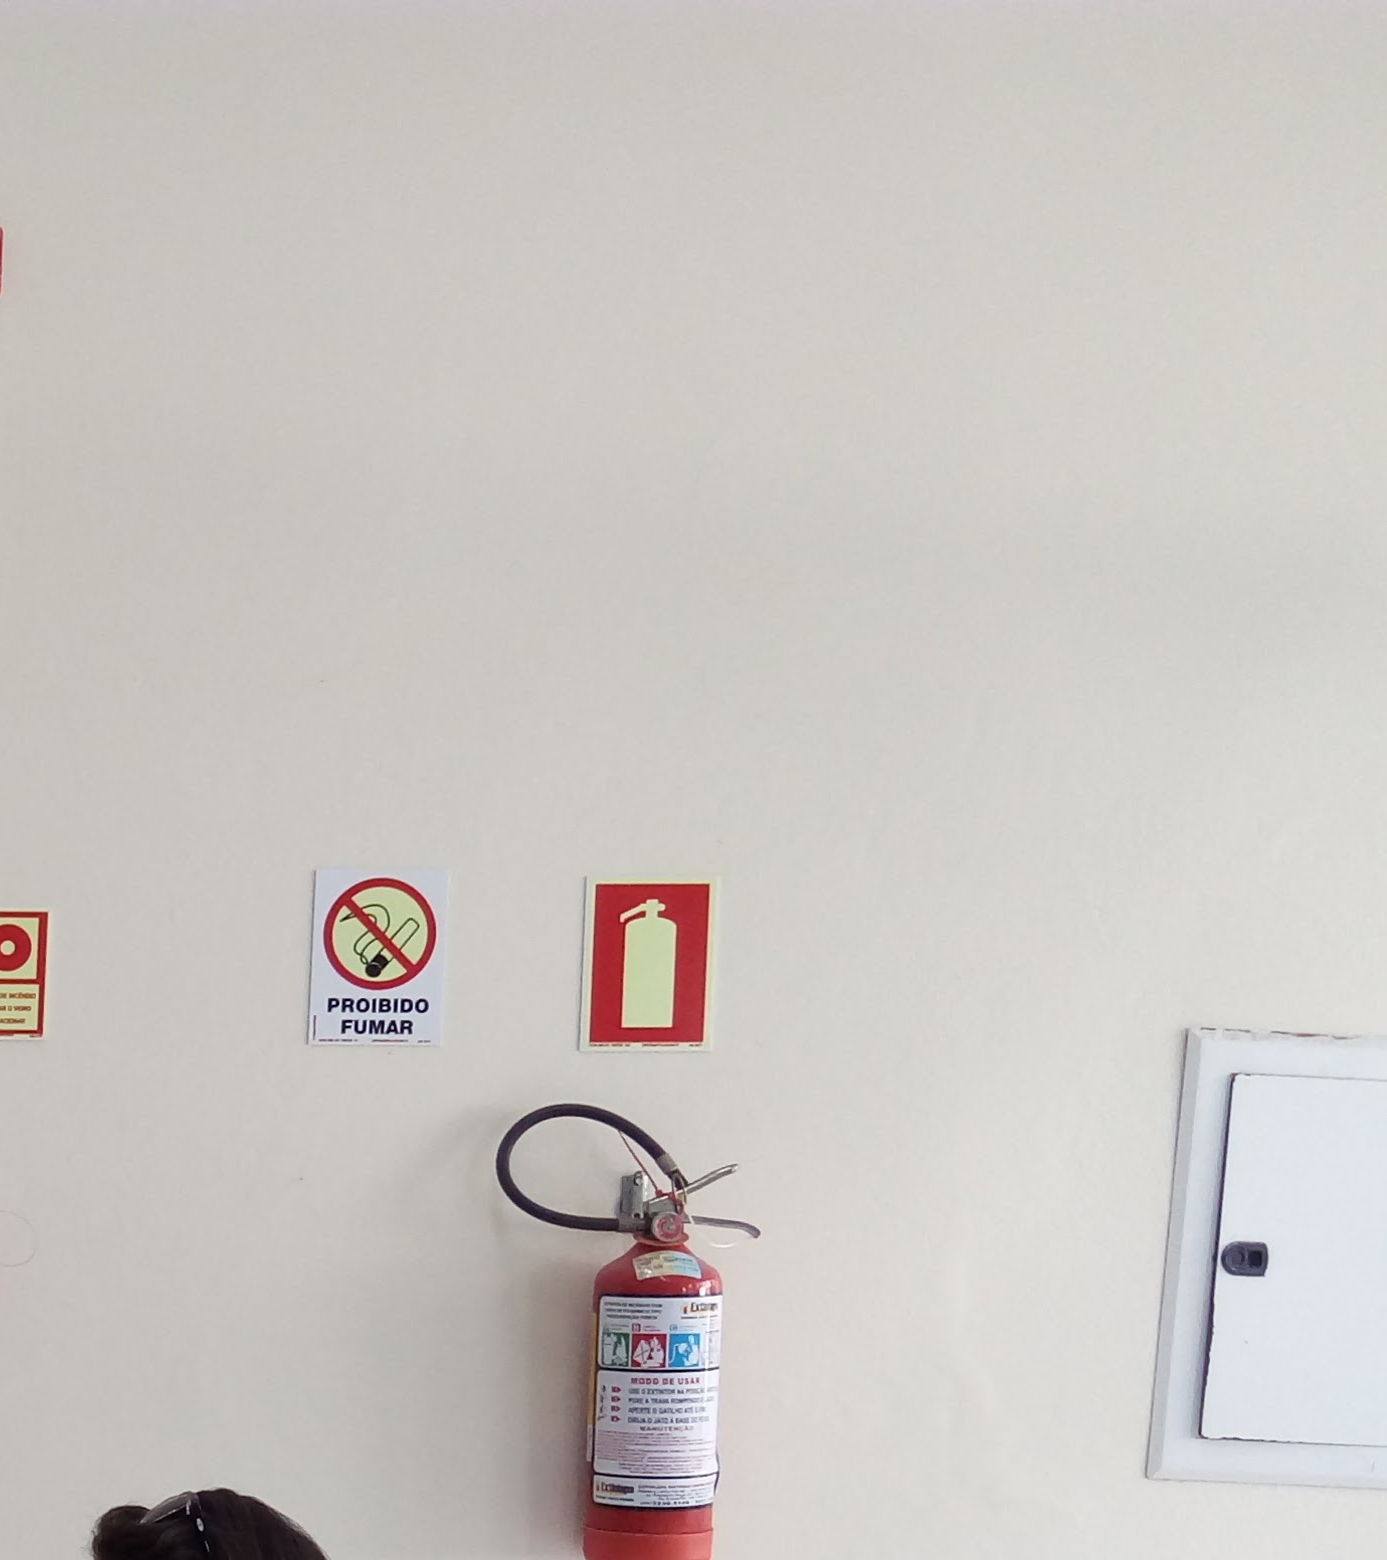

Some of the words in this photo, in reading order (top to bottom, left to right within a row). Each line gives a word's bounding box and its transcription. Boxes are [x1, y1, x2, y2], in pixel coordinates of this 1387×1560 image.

[327, 998, 429, 1014] PROIBIDO
[341, 1019, 414, 1035] FUMAR
[631, 1377, 659, 1385] MODO
[662, 1377, 674, 1385] DE
[677, 1377, 700, 1385] USAR
